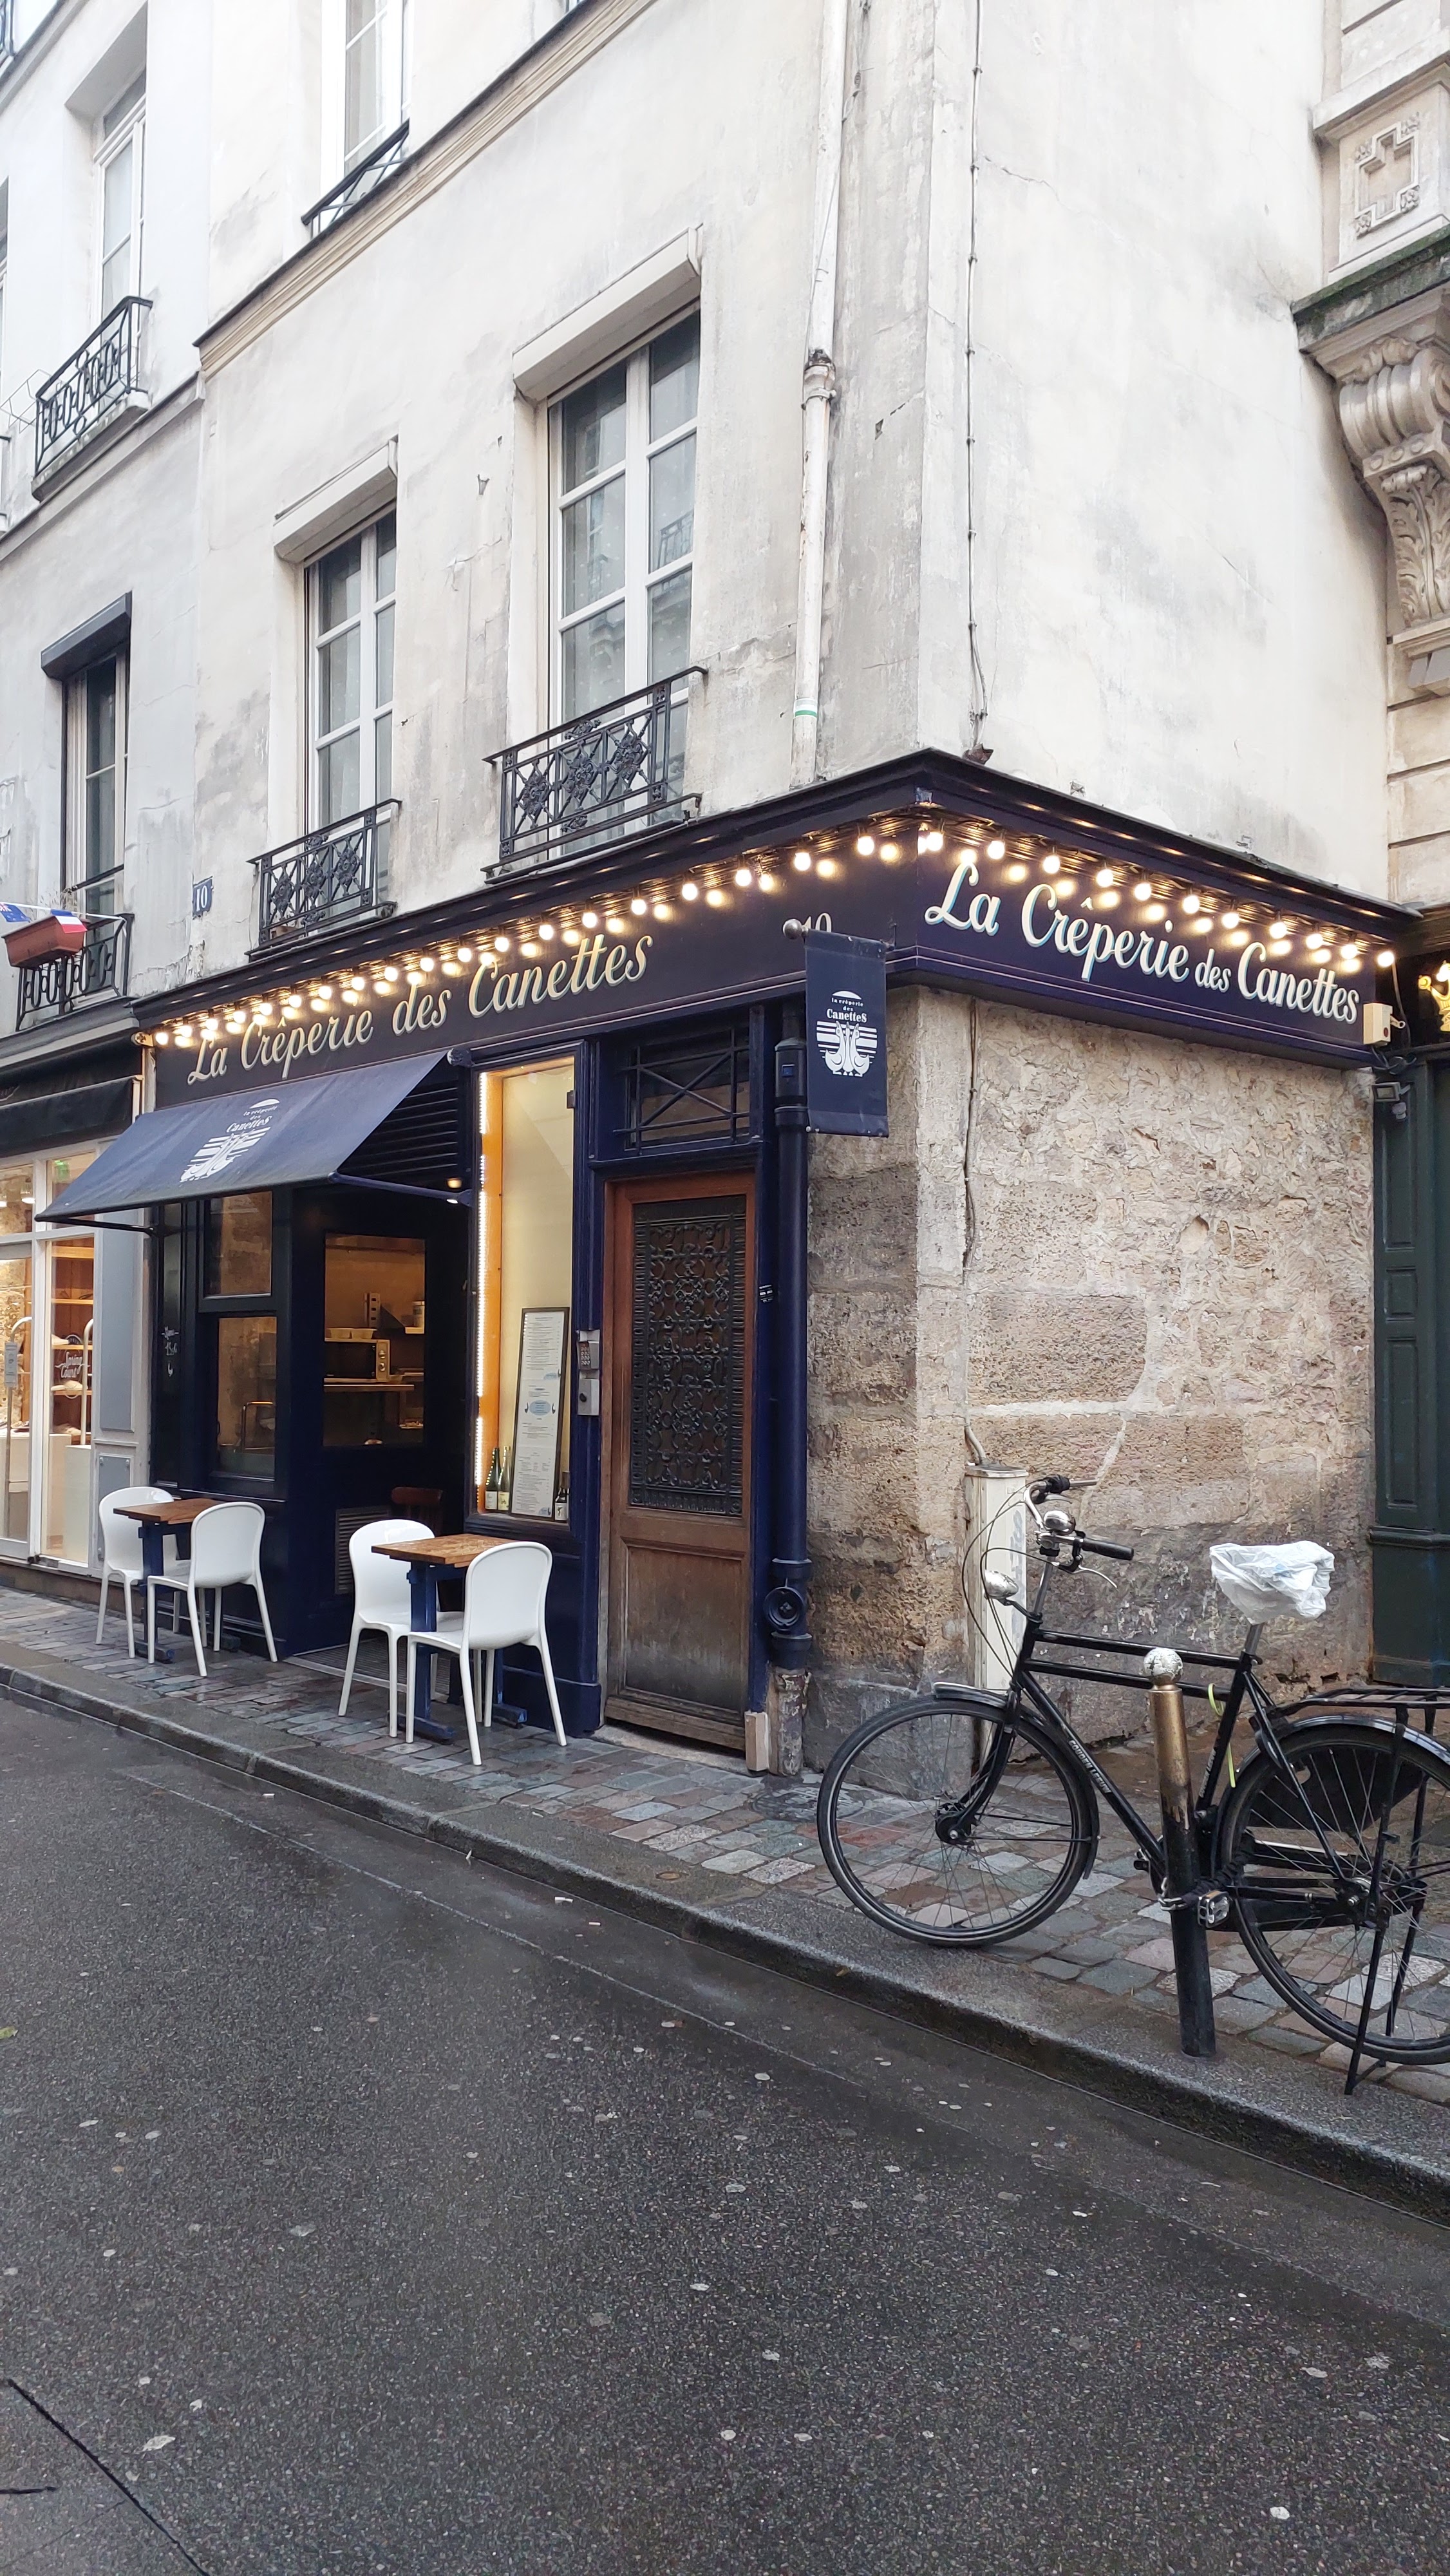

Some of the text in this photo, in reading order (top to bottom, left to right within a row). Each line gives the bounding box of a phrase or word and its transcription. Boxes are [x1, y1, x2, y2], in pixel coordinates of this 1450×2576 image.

[196, 885, 208, 912] 10
[925, 862, 1360, 1025] La Crêperie des Canettes
[187, 934, 653, 1085] La Crêperie des Canettes
